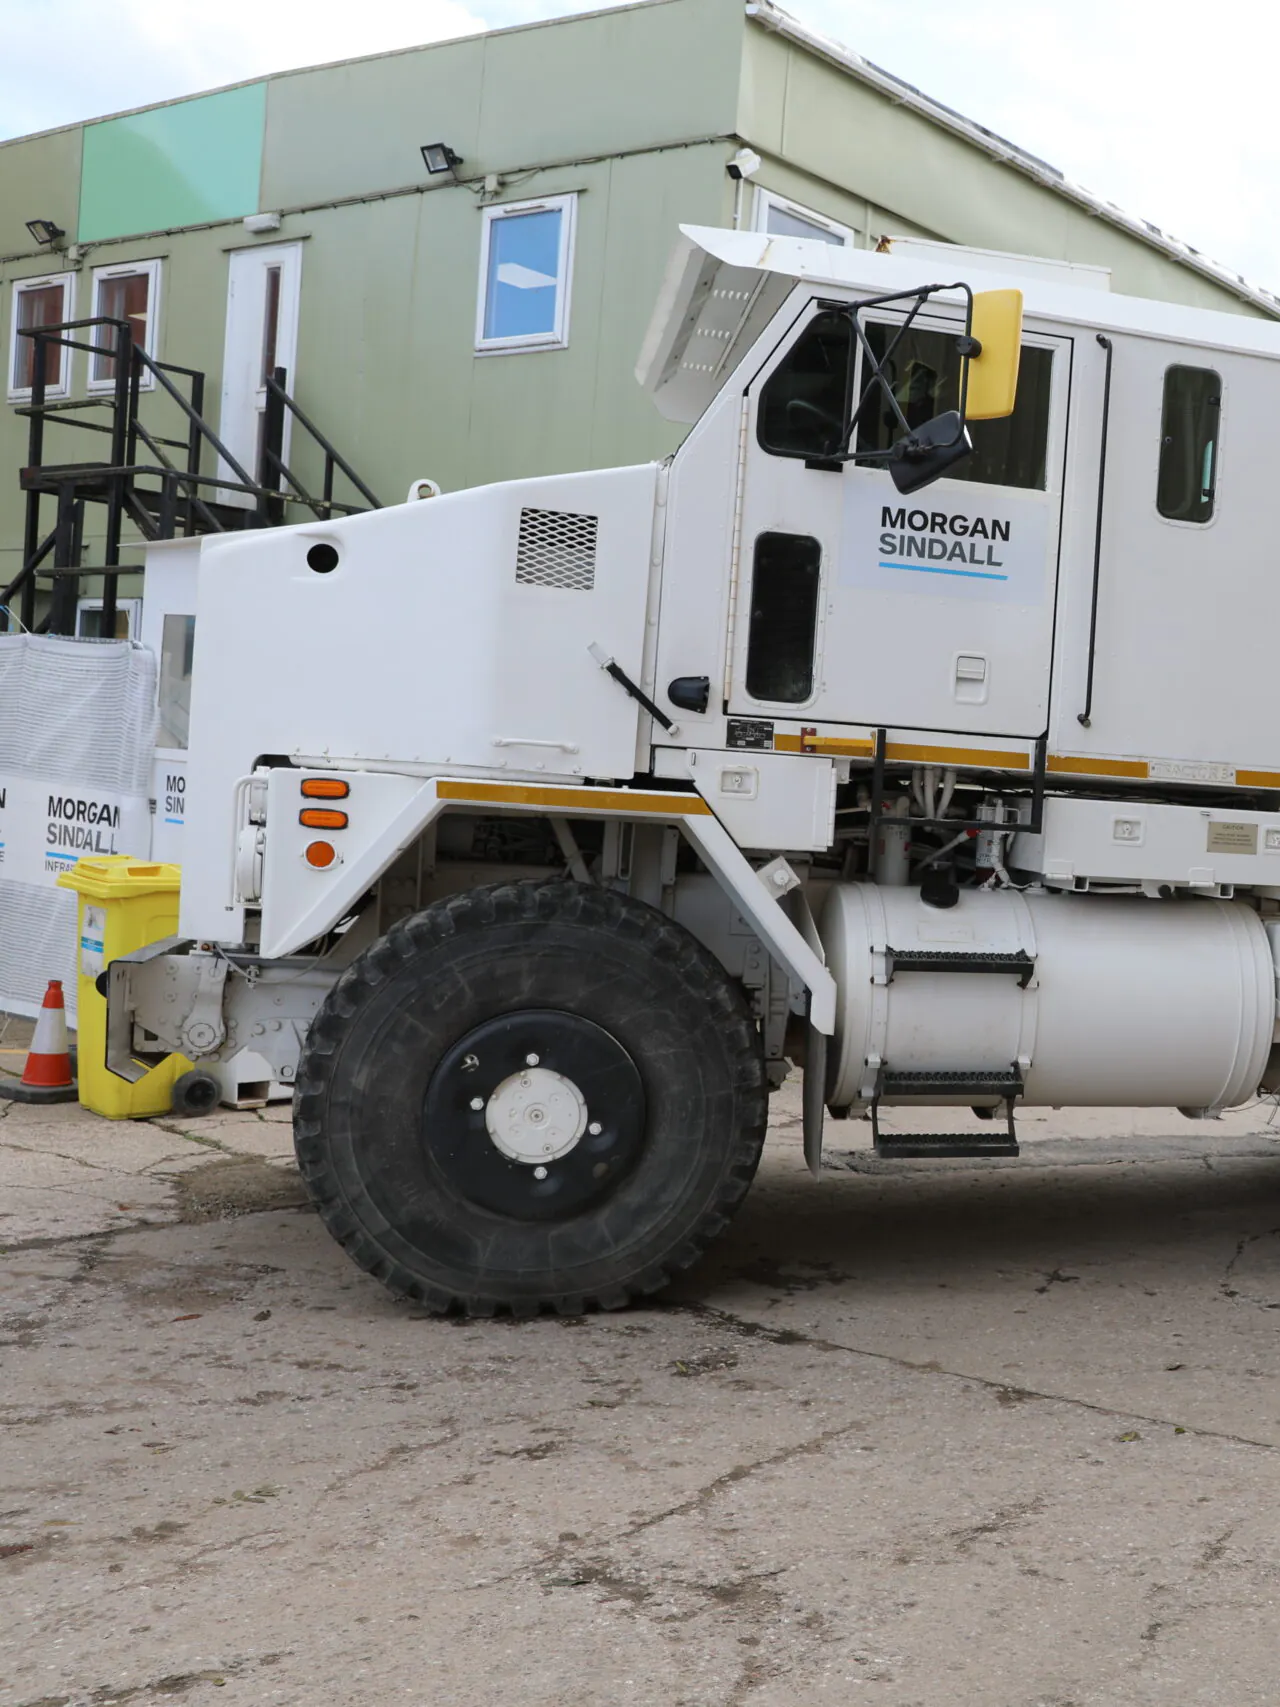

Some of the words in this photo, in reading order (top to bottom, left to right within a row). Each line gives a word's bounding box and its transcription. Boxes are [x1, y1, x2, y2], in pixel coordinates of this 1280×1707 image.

[881, 506, 1011, 542] MORGAN
[878, 532, 1003, 567] SINDALL
[48, 795, 121, 828] MORGAN
[46, 822, 118, 855] SINDALL
